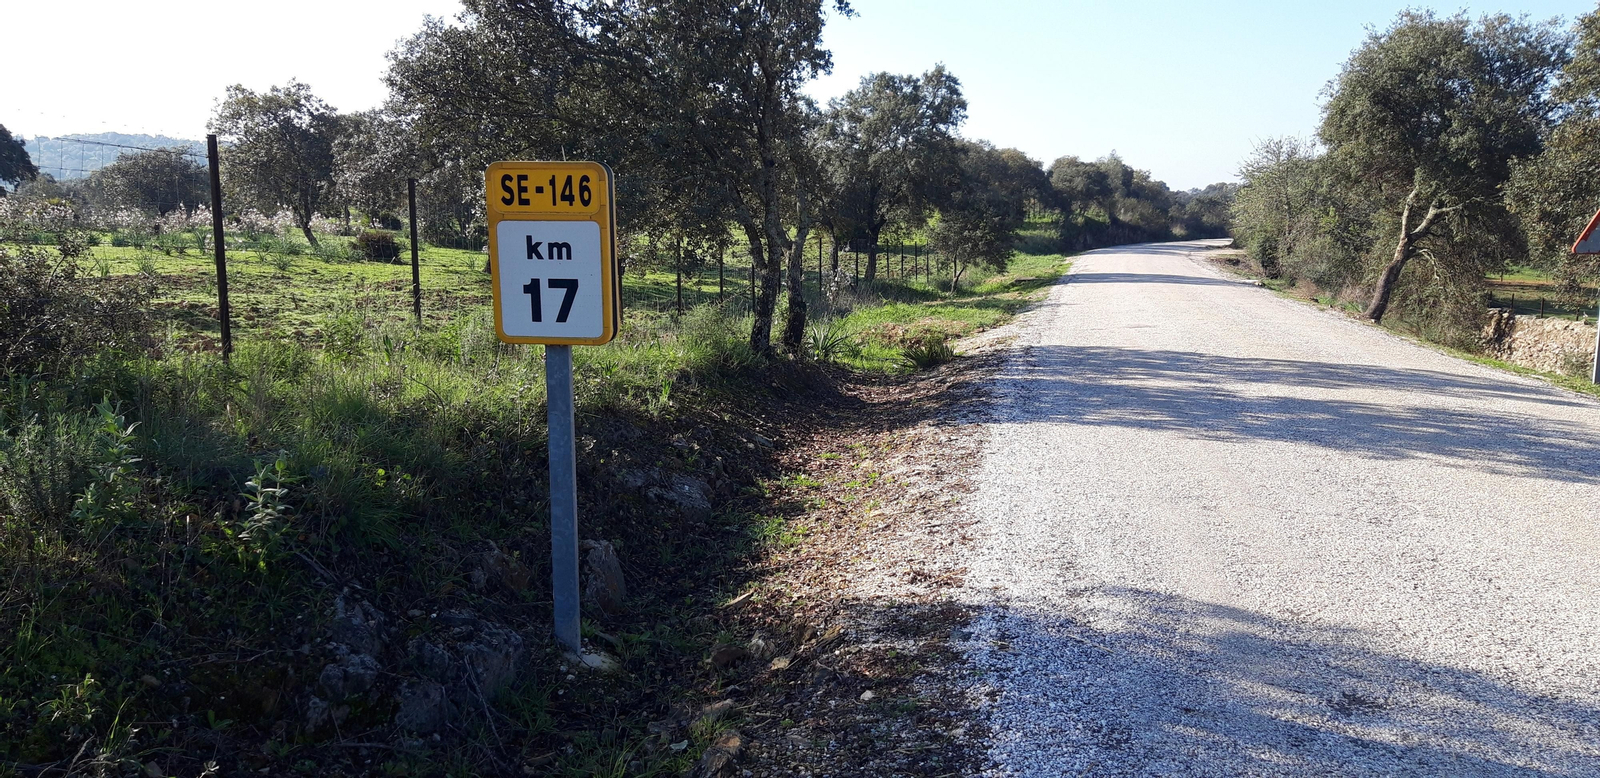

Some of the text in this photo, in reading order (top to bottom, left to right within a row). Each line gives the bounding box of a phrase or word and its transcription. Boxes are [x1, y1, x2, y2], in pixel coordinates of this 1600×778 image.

[500, 173, 592, 207] SE-146
[525, 234, 573, 261] km
[522, 278, 580, 323] 17
